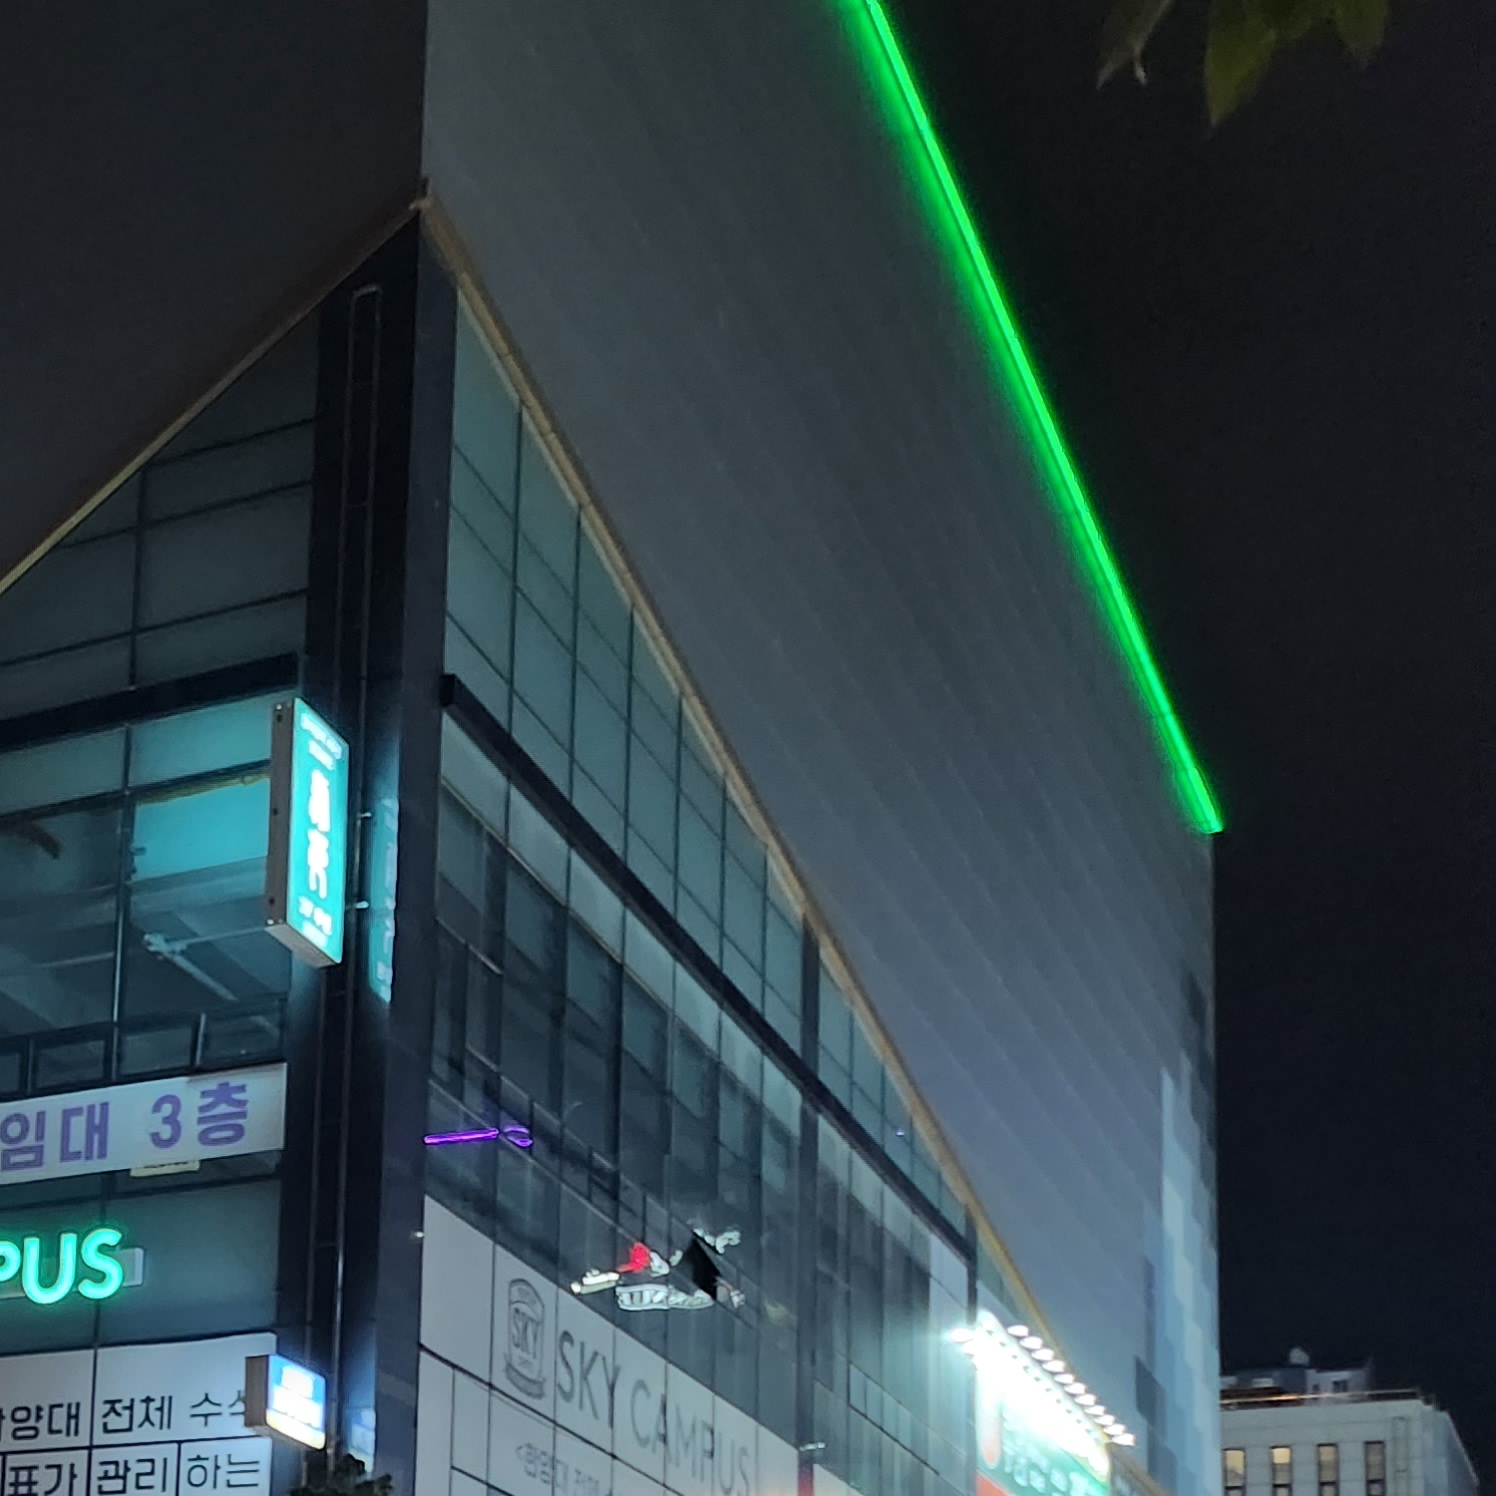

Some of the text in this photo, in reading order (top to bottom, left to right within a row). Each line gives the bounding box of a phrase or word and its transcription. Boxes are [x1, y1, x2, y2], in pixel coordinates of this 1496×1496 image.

[150, 1081, 249, 1149] 3층
[557, 1330, 621, 1429] SKY
[101, 1394, 173, 1434] 전체
[96, 1455, 169, 1496] 관리
[186, 1453, 261, 1491] 하는
